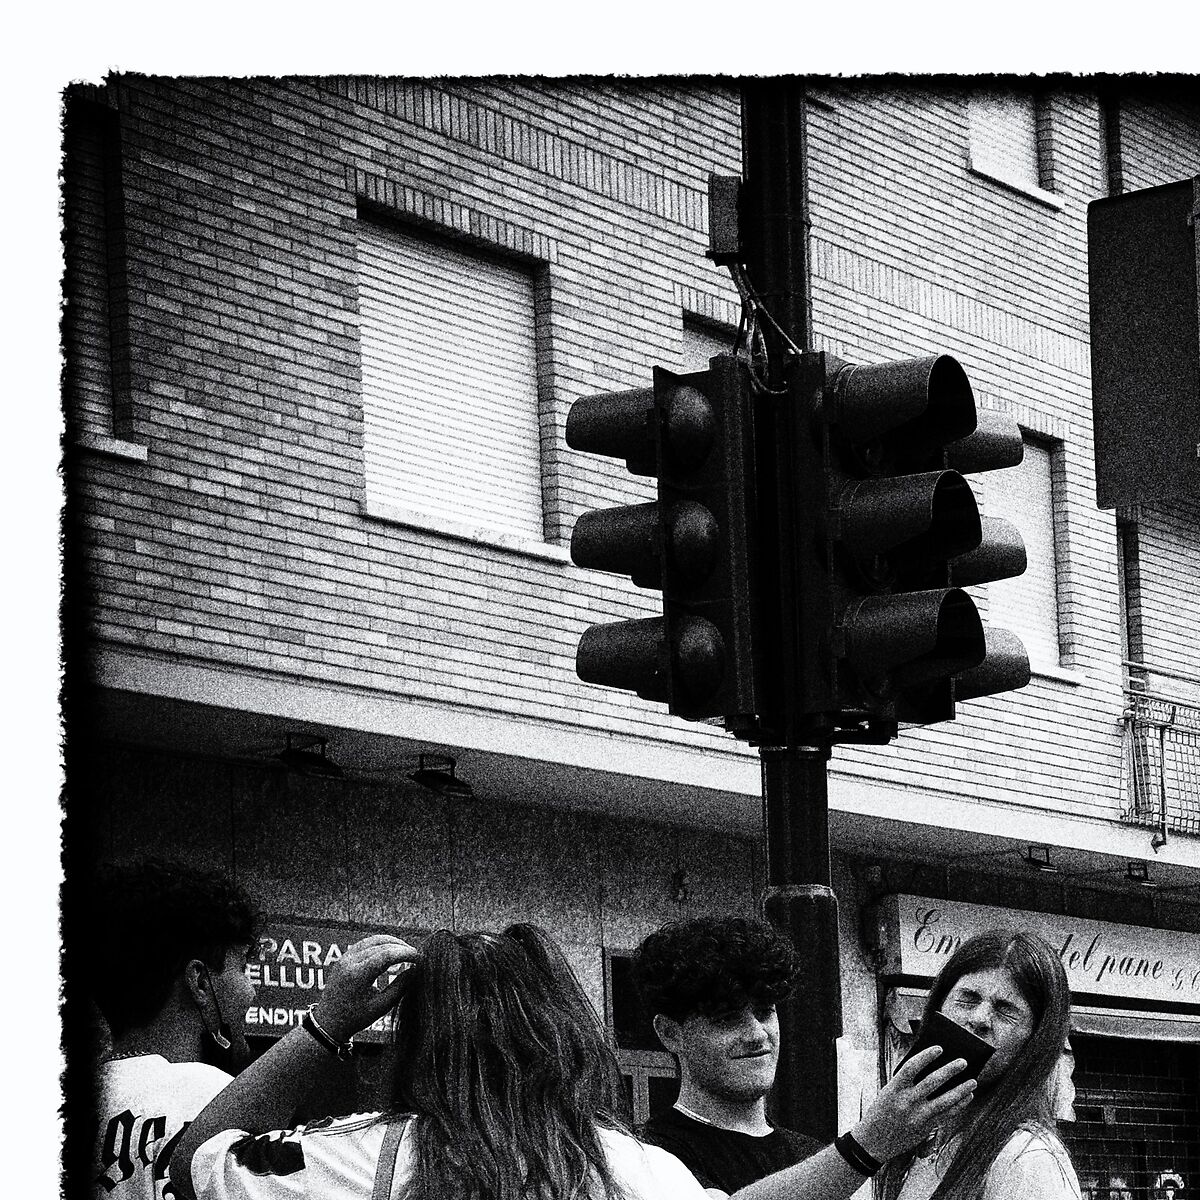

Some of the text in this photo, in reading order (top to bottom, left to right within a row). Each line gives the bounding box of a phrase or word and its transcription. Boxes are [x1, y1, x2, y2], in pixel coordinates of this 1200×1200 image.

[258, 936, 344, 967] PARA
[1095, 955, 1163, 982] pane
[244, 1005, 309, 1027] ENDIT
